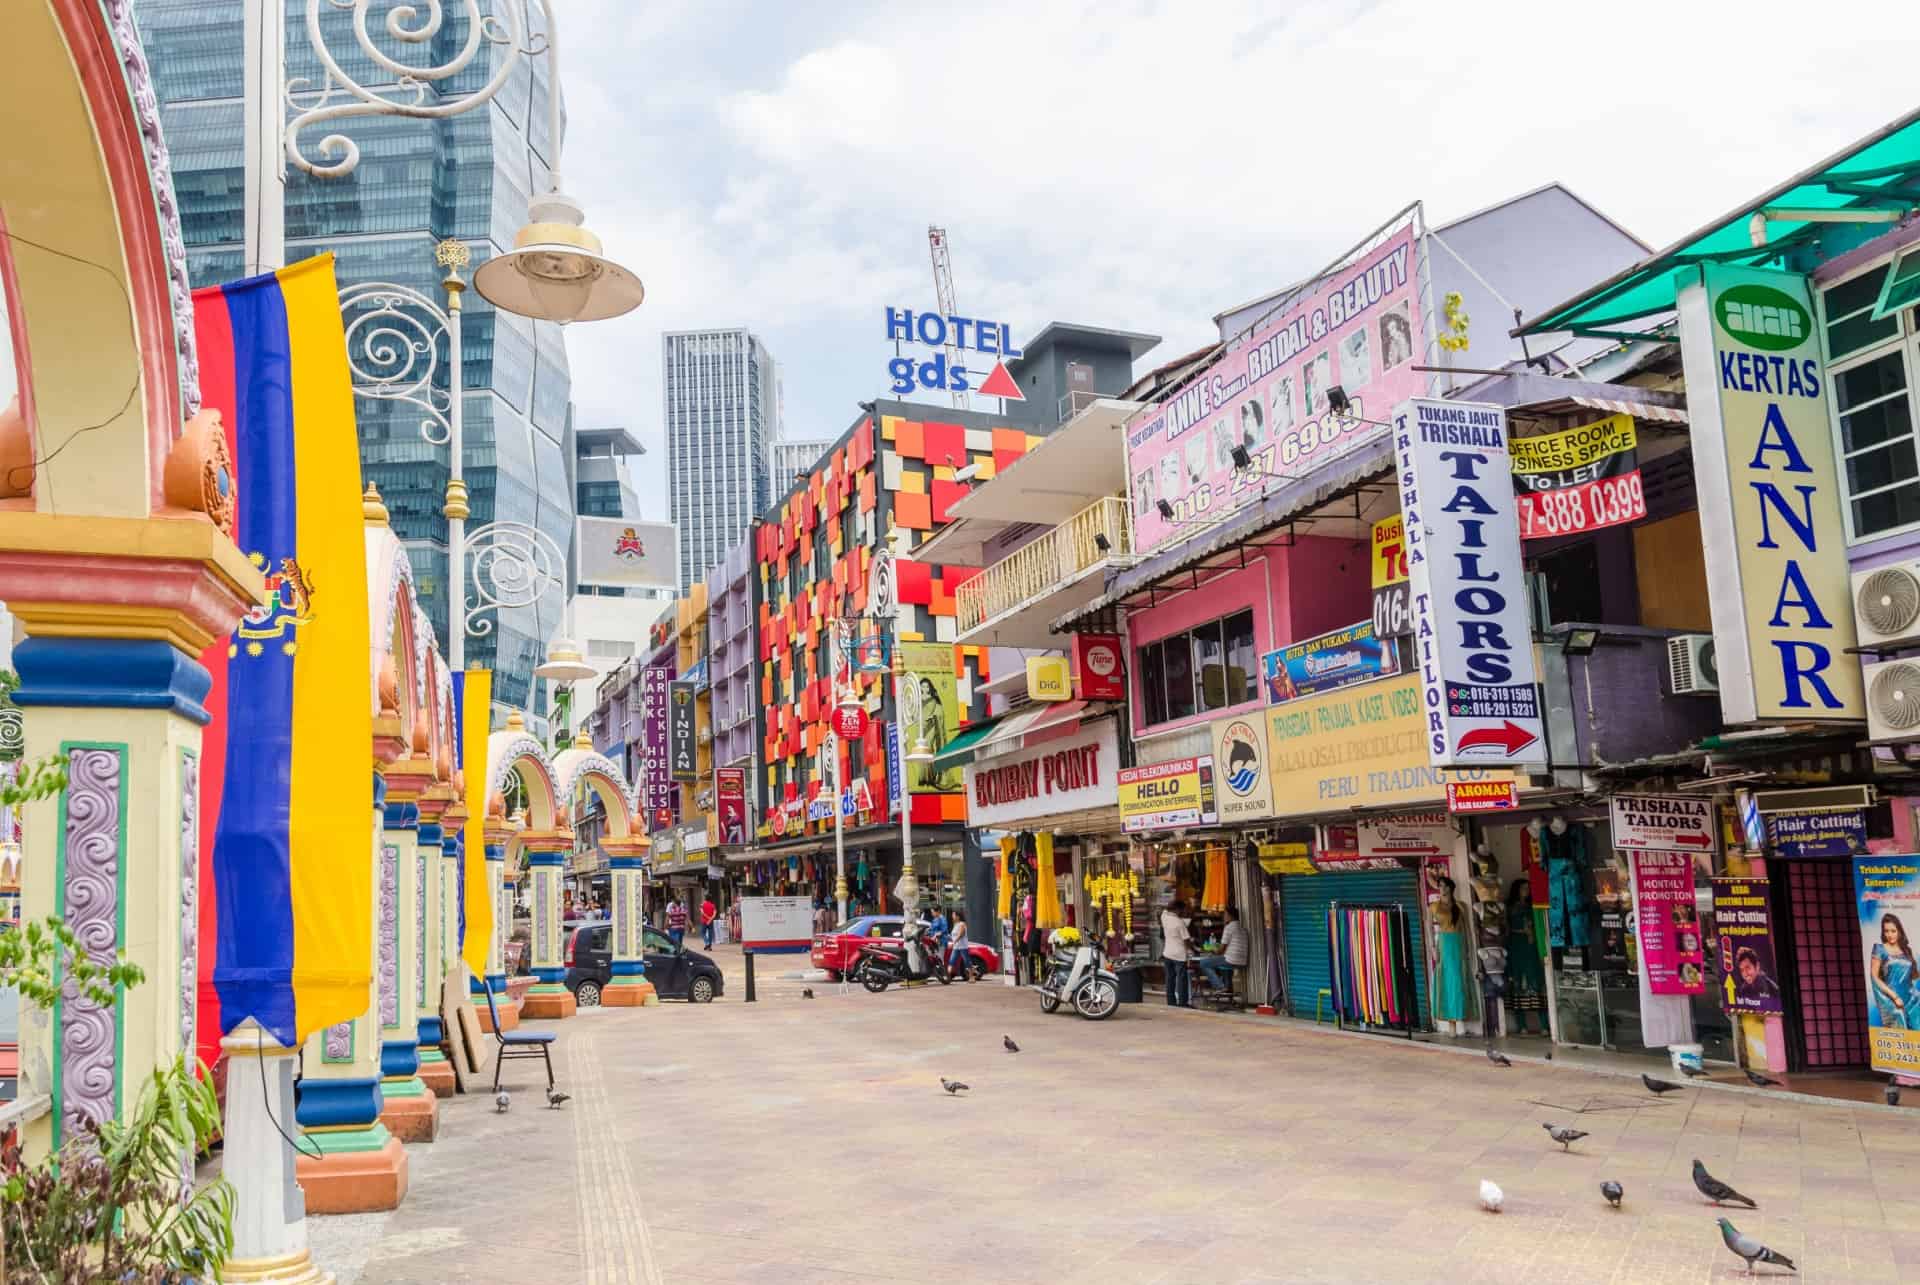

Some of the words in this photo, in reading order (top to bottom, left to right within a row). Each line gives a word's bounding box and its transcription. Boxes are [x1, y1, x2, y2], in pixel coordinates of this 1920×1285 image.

[886, 306, 1023, 359] HOTEL
[1166, 377, 1211, 442] ANNE
[1248, 314, 1310, 381] BRIDAL
[1311, 308, 1329, 343] &
[1328, 242, 1409, 331] BEAUTY
[888, 353, 969, 394] gds
[1720, 350, 1820, 399] KERTAS
[1417, 405, 1465, 424] TUKANG
[1469, 409, 1499, 427] JAHIT
[1418, 423, 1503, 449] TRISHALA
[1508, 438, 1560, 456] OFFICE
[1565, 421, 1616, 448] ROOM
[1579, 432, 1632, 461] SPACE
[1559, 461, 1600, 487] LET
[1522, 490, 1585, 534] 7-888
[1590, 474, 1644, 525] 0399
[1439, 451, 1513, 684] TAILORS
[1749, 403, 1844, 708] ANAR
[1395, 414, 1425, 564] TRISHALA
[1416, 593, 1446, 754] TAILORS
[646, 671, 655, 719] PARK
[1389, 687, 1418, 716] VIDEO
[1512, 703, 1534, 716] 5231
[842, 717, 860, 726] ZEN
[656, 670, 668, 808] BRICKFIELDS
[676, 708, 690, 769] INDIAN
[647, 746, 657, 808] HOTEL
[975, 758, 1040, 808] BOMBAY
[1042, 742, 1100, 795] POINT
[1137, 779, 1180, 799] HELLO
[1319, 776, 1359, 800] PERU
[1368, 767, 1446, 793] TRADING
[842, 787, 855, 815] ds
[1456, 783, 1509, 797] AROMAS
[1616, 798, 1708, 816] TRISHALA
[1624, 813, 1702, 829] TAILORS
[1778, 818, 1806, 832] Hair
[1810, 814, 1862, 829] Cutting
[1639, 890, 1692, 900] PROMOTION
[1643, 879, 1685, 889] MONTHLY
[1716, 910, 1736, 922] Hair
[1737, 910, 1767, 924] Cutting
